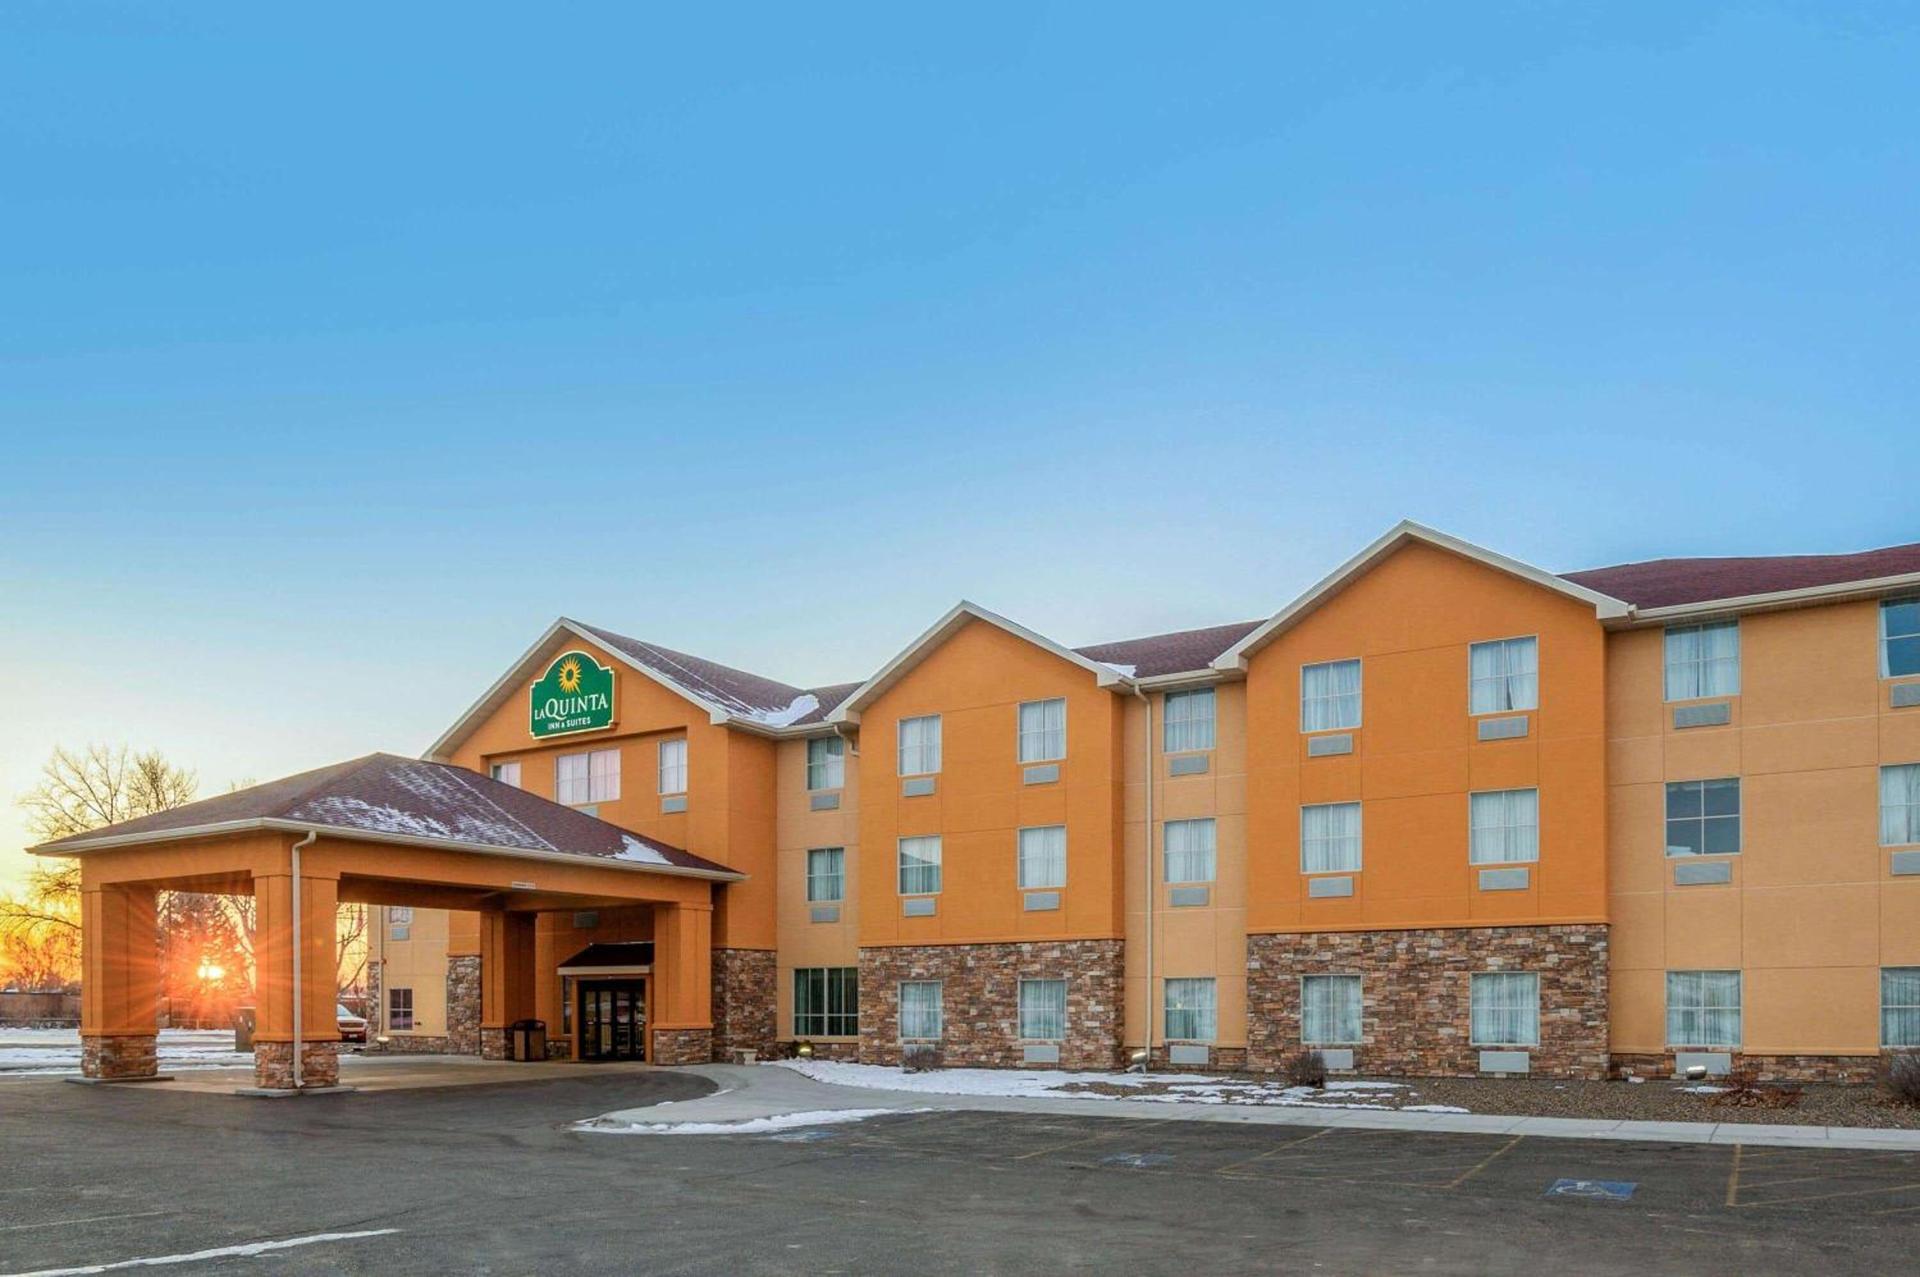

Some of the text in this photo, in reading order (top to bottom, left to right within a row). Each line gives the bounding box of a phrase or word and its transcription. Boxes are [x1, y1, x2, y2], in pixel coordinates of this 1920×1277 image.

[534, 693, 608, 720] LA QUINTA
[547, 722, 560, 730] INN
[566, 716, 591, 728] SUITES
